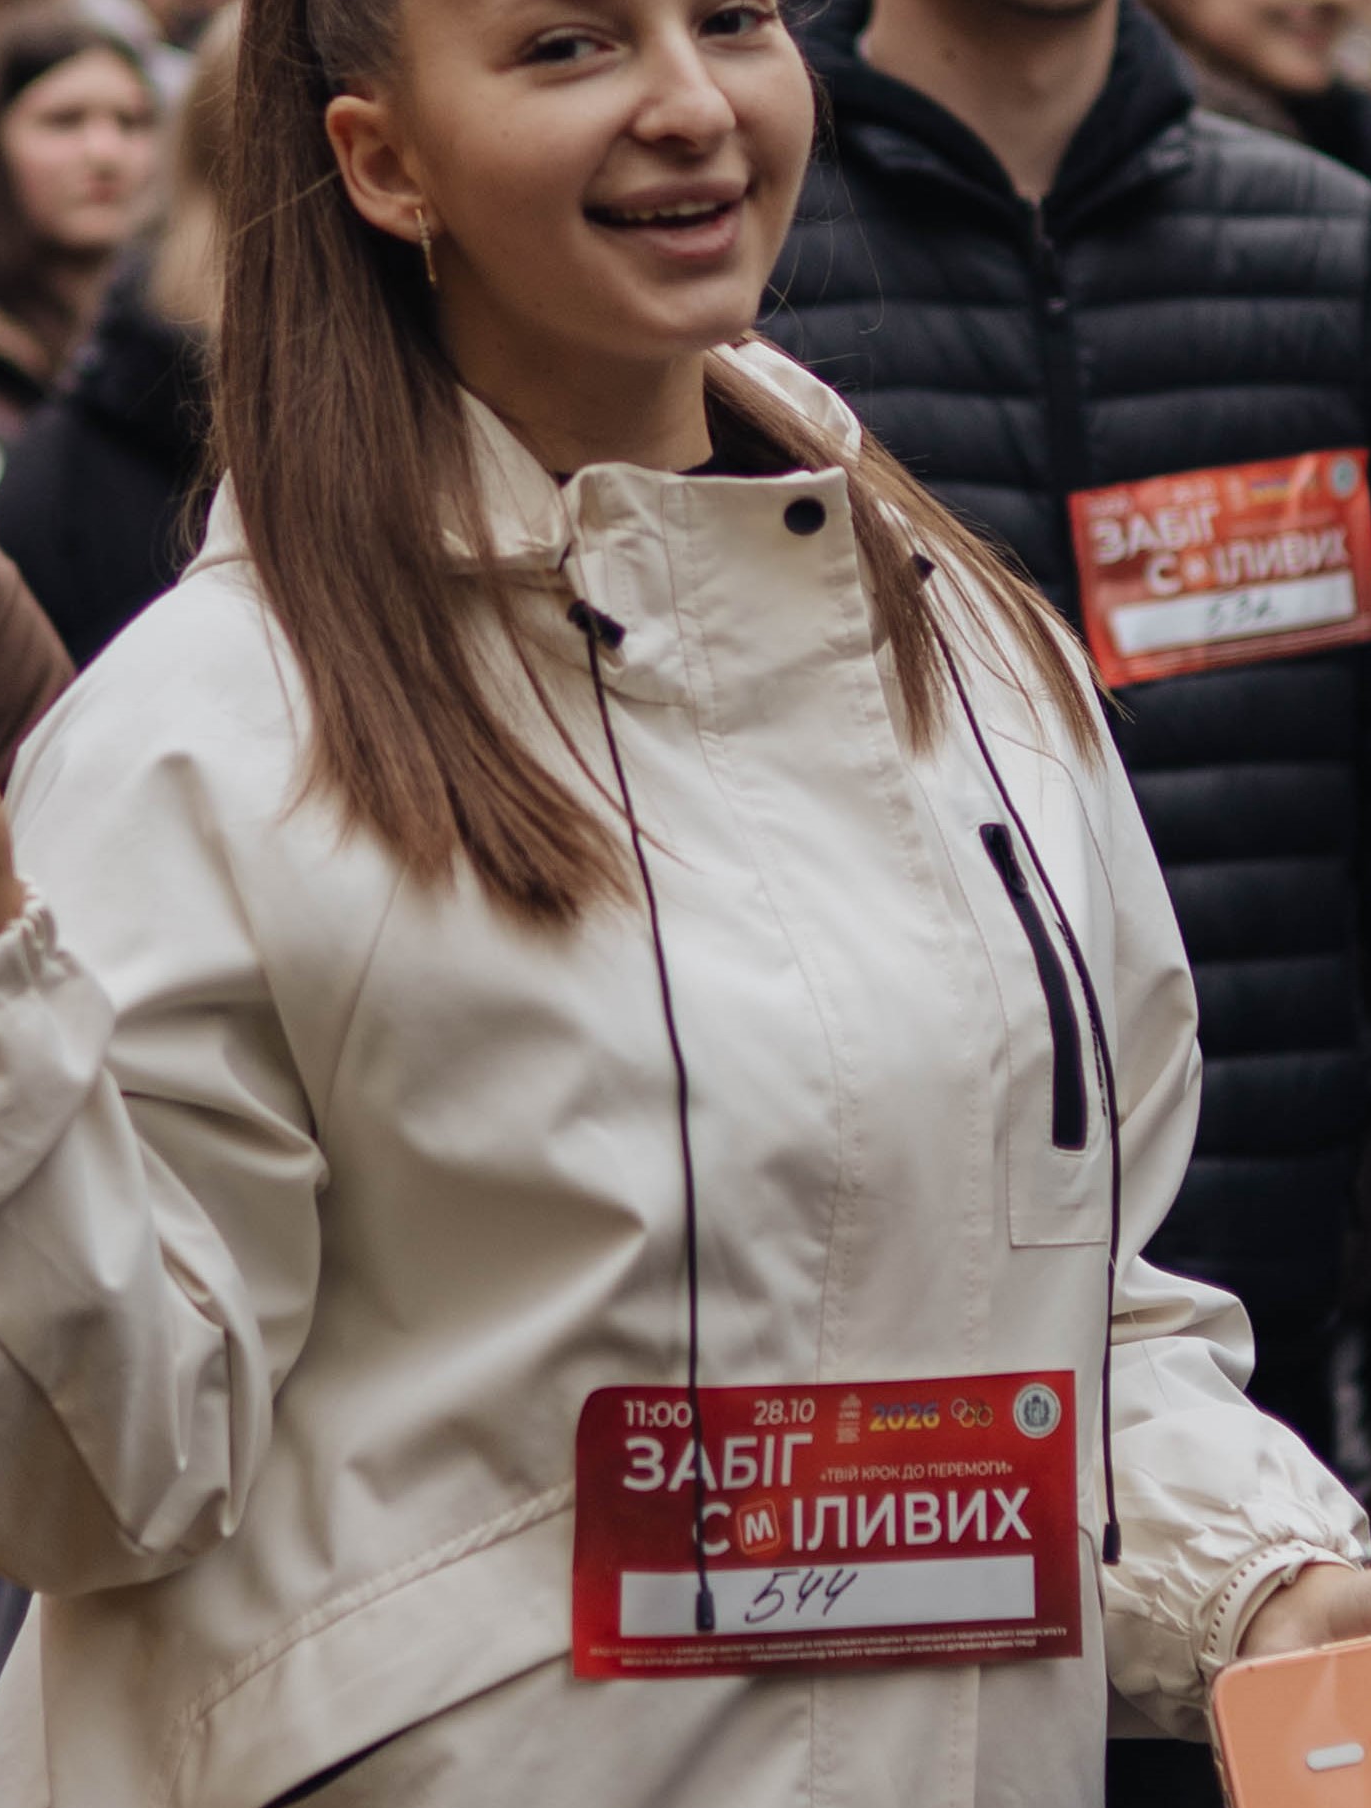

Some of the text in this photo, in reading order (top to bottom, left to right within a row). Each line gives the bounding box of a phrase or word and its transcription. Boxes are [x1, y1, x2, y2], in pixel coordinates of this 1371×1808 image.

[1090, 500, 1220, 565] ЗАБІГ
[624, 1400, 693, 1428] 11:00
[753, 1398, 816, 1426] 28.10
[868, 1401, 942, 1432] 2026
[623, 1433, 813, 1492] ЗАБІГ
[862, 1463, 900, 1481] КРОК
[901, 1463, 925, 1481] ДО
[744, 1568, 858, 1624] 544
